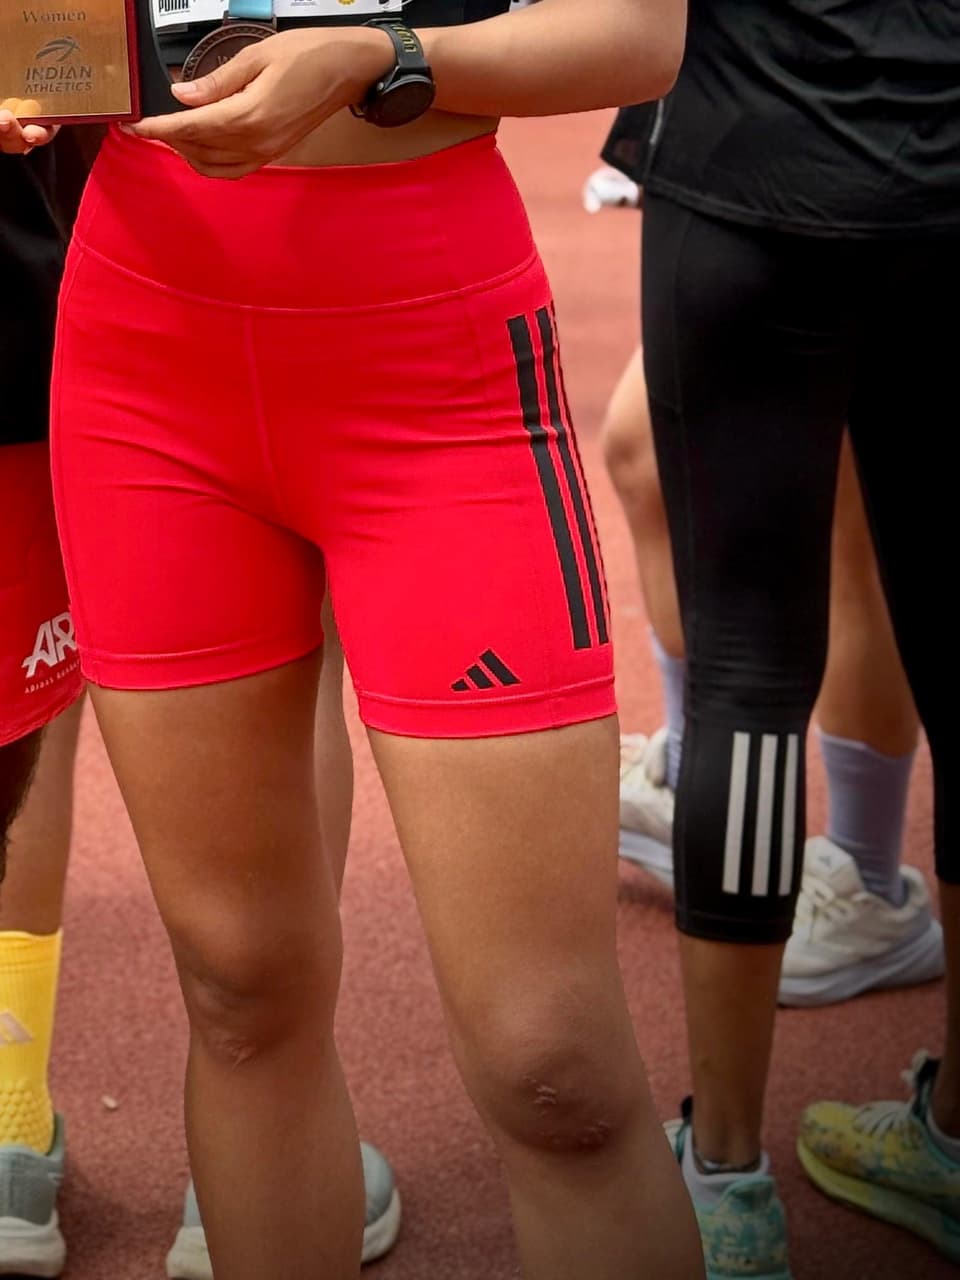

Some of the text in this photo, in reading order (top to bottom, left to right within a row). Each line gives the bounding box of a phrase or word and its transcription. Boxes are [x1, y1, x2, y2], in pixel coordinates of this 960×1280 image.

[23, 10, 86, 22] Women
[25, 66, 92, 81] INDIAN
[25, 81, 92, 94] ATHLETICS
